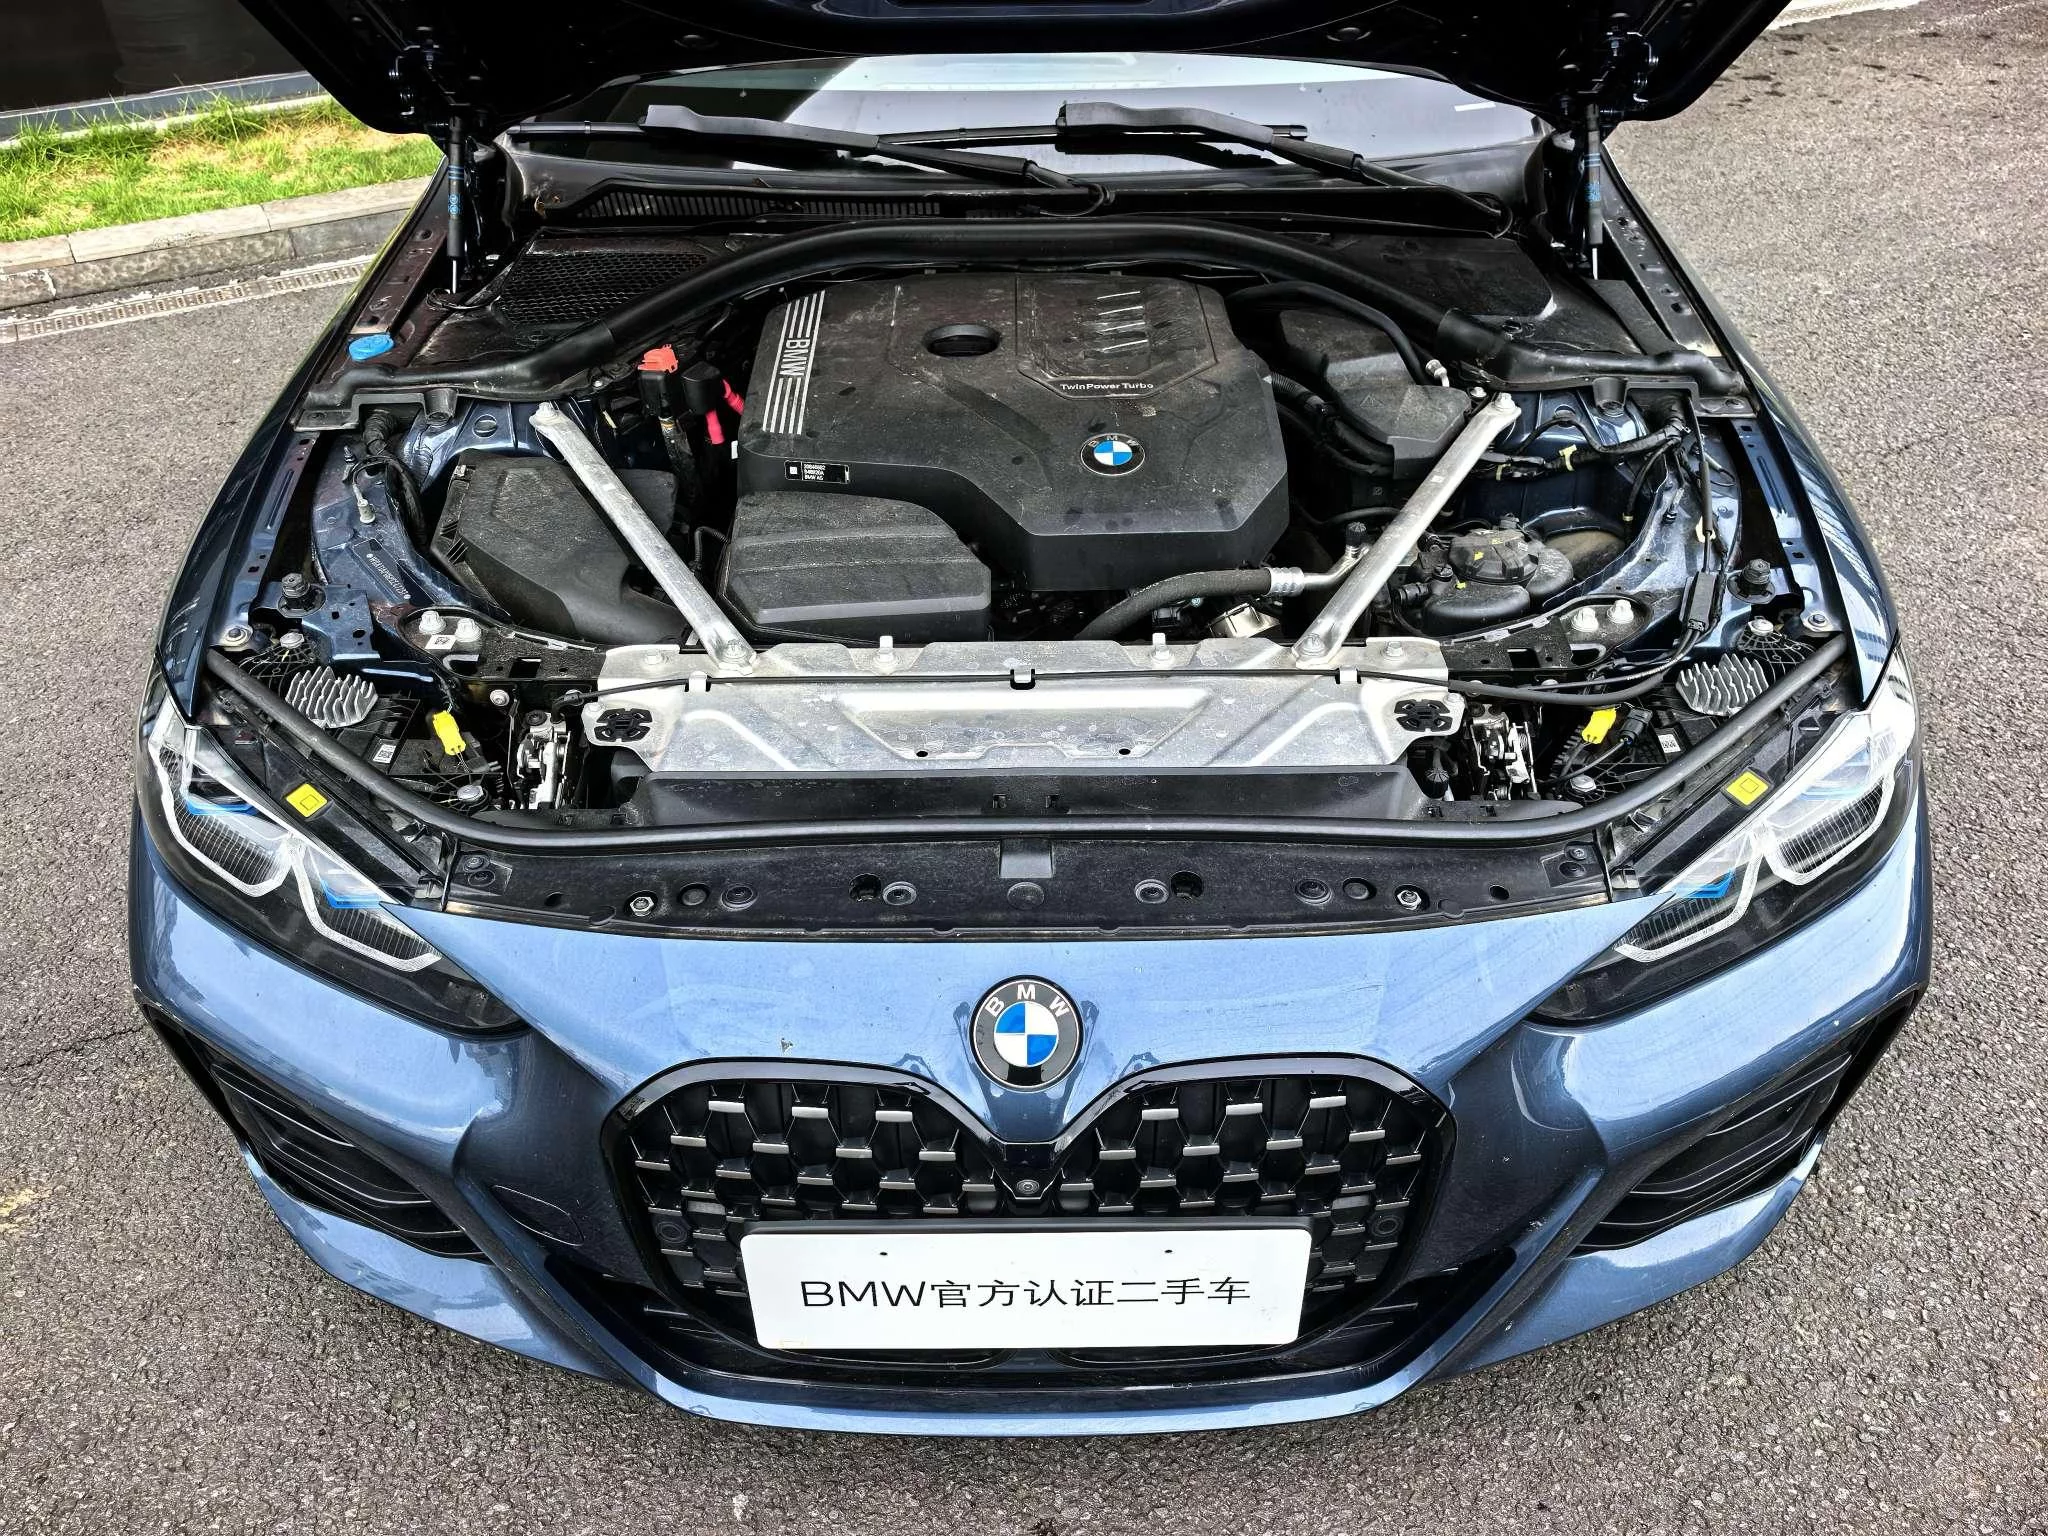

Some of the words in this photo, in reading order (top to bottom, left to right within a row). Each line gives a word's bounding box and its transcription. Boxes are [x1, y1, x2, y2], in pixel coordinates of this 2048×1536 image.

[780, 338, 811, 376] BMW
[1121, 382, 1154, 390] Turbo
[984, 983, 1071, 1018] BMW
[800, 1276, 1251, 1308] BMW官方认证二手车
